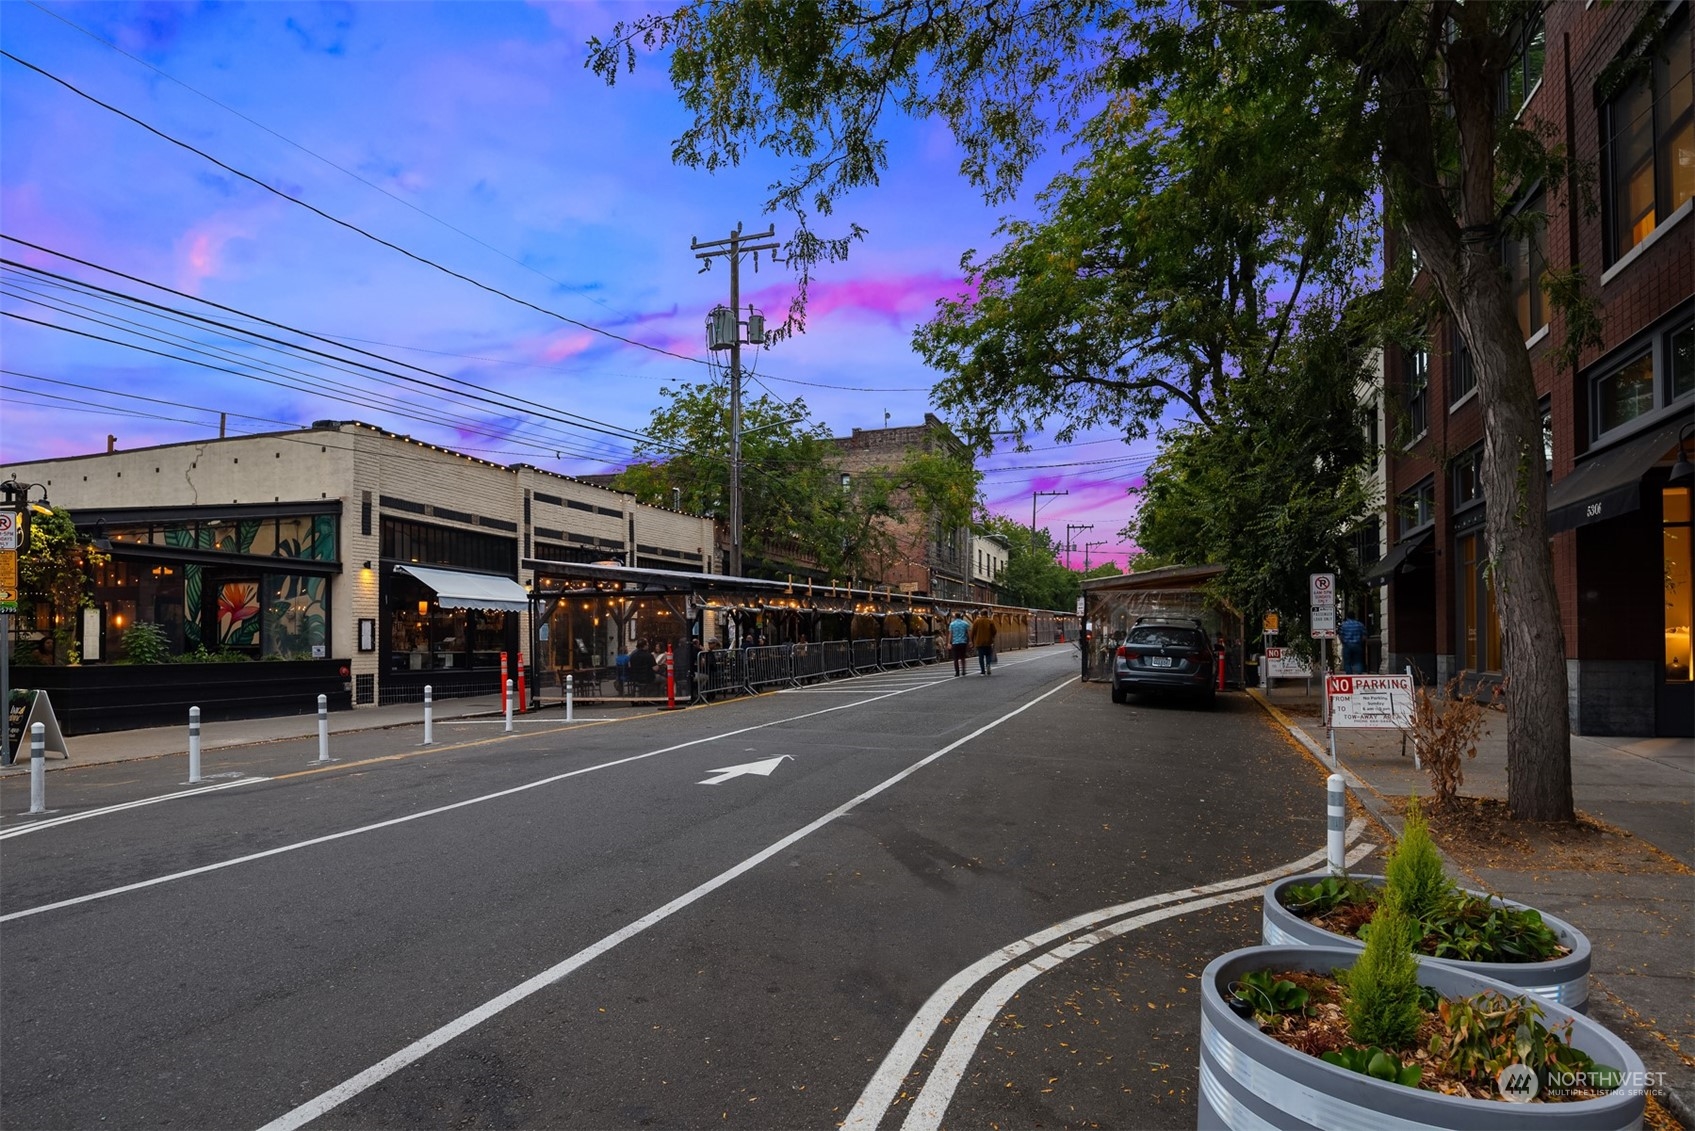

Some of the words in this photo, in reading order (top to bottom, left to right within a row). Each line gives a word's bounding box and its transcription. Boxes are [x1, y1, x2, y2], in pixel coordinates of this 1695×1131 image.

[1268, 649, 1279, 657] NO
[1332, 679, 1349, 692] NO
[1356, 679, 1408, 690] PARKING
